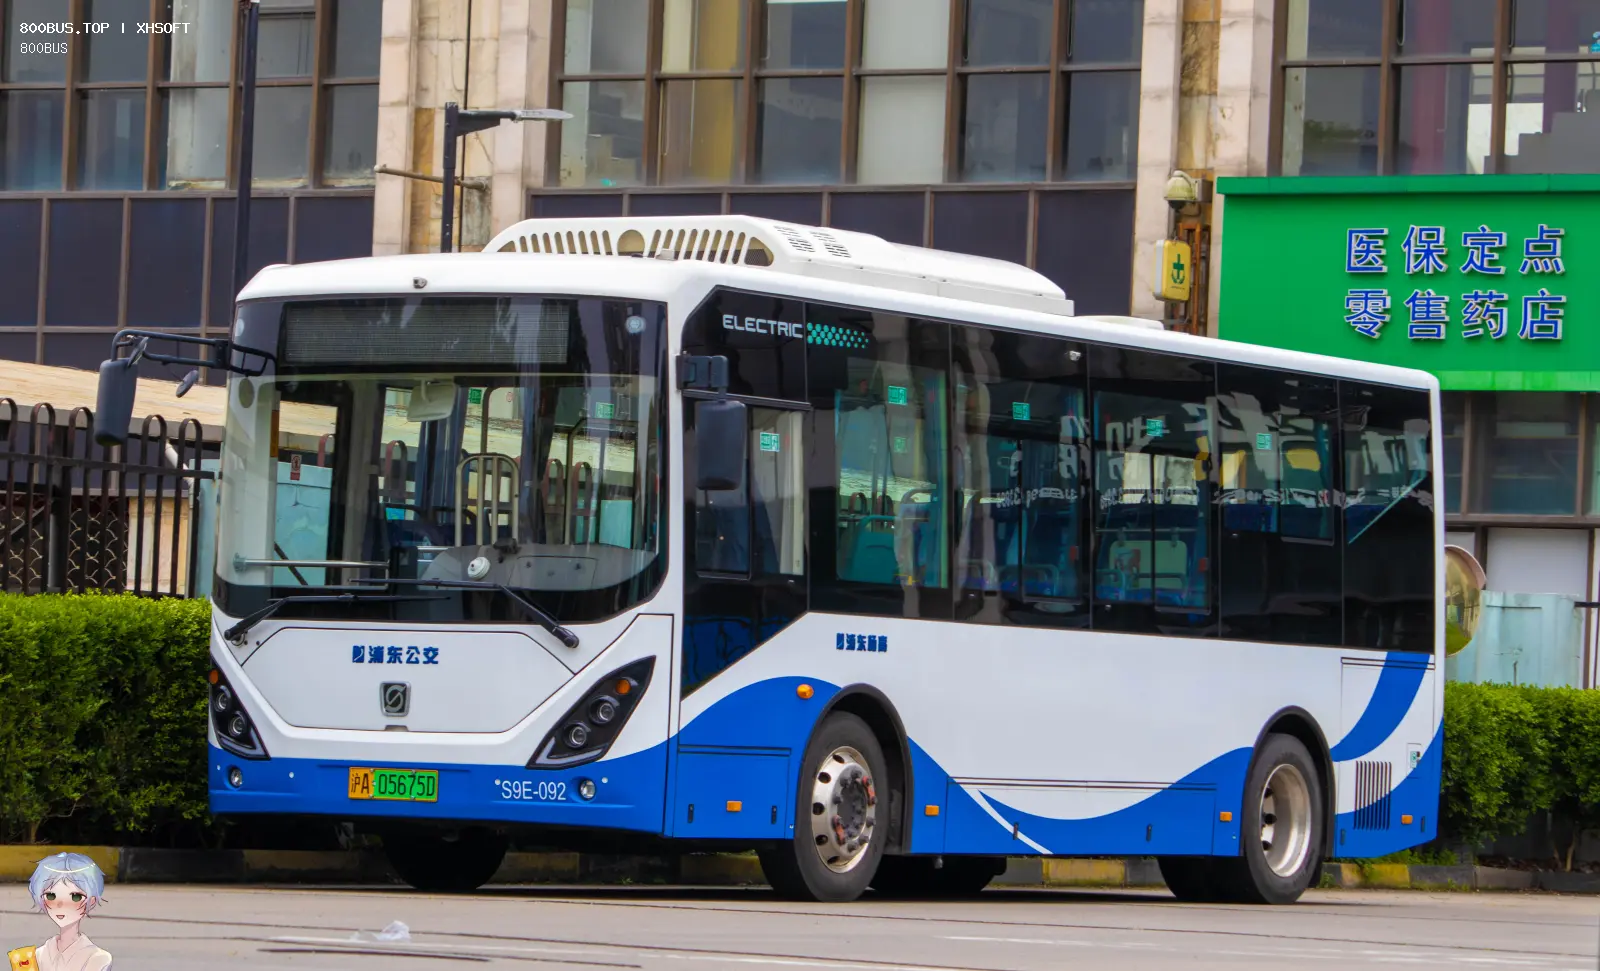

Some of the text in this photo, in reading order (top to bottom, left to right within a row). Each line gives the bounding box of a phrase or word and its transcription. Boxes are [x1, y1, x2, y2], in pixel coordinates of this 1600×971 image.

[1345, 224, 1565, 275] 医保定点
[722, 314, 804, 339] ELECTRIC
[1344, 288, 1567, 340] 零售药店
[368, 645, 439, 665] 浦东公交
[501, 780, 567, 800] S9E-092
